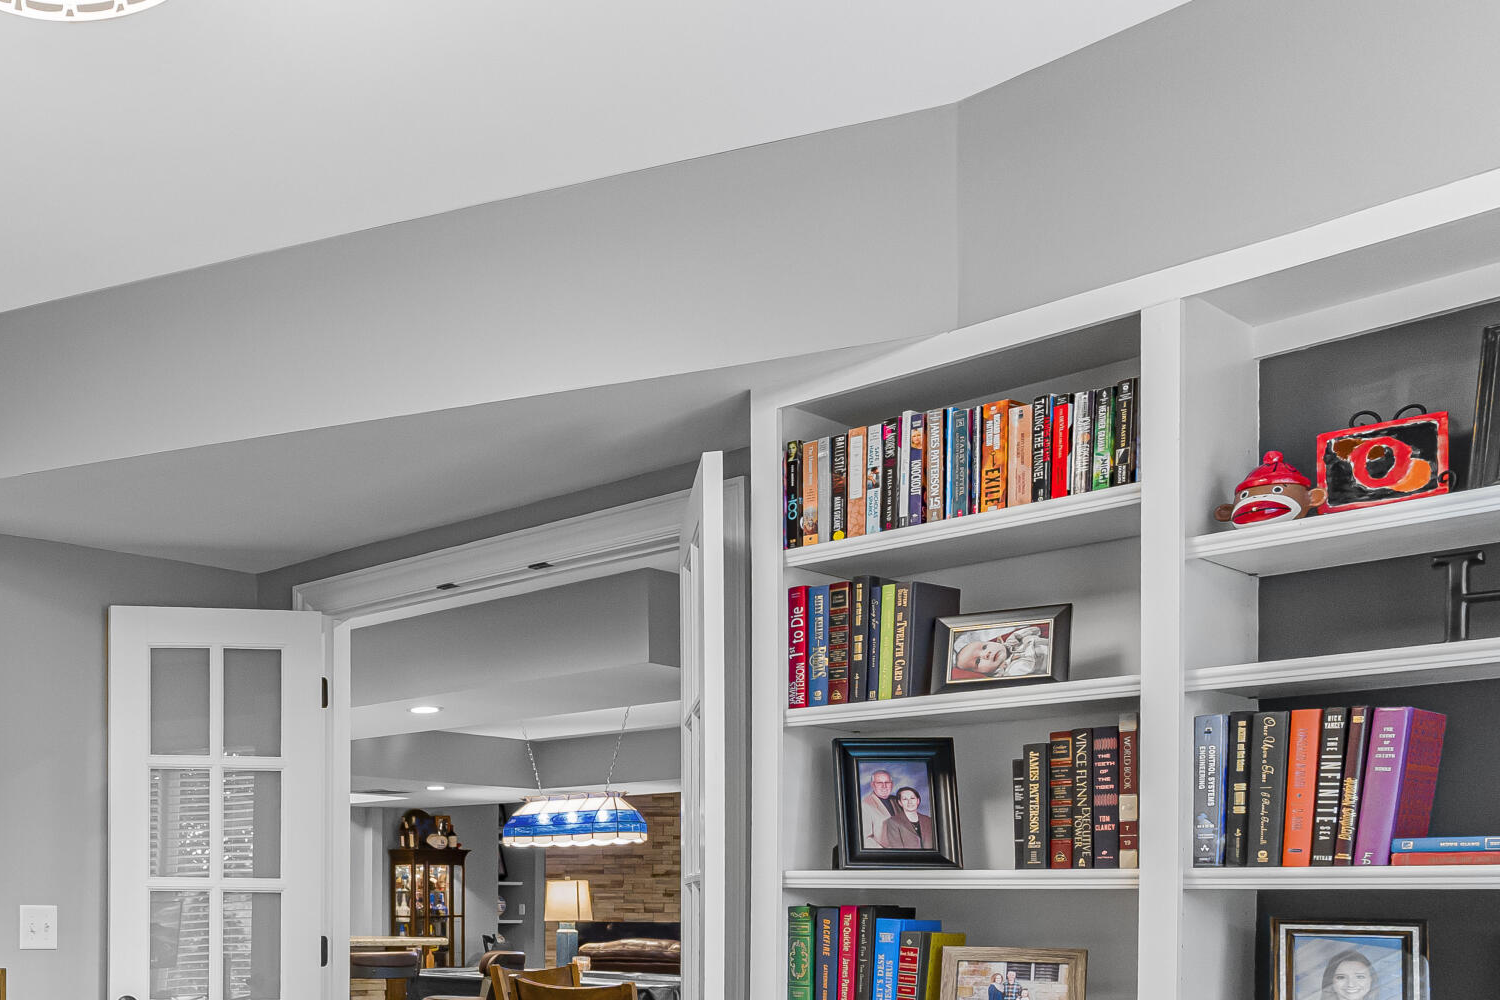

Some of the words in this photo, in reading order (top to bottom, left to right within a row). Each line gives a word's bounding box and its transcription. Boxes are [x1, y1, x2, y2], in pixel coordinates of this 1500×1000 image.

[1035, 398, 1045, 430] TAKING
[930, 423, 941, 448] JAMES
[1034, 432, 1044, 448] THE
[911, 459, 921, 496] KNOCKOUT
[930, 449, 941, 497] PATTERSON
[1033, 450, 1043, 482] TUNNEL
[985, 468, 1001, 506] EXILE
[791, 606, 804, 628] Die
[815, 595, 824, 614] KITTY
[794, 630, 804, 643] to
[815, 617, 824, 640] KELLEY
[896, 621, 908, 657] TWELFTH
[789, 646, 804, 660] 1st
[812, 646, 827, 680] ROYALS
[796, 662, 805, 704] PATTERSON
[894, 659, 906, 681] CARD
[789, 681, 797, 705] JAMES
[1263, 716, 1276, 736] Once
[1324, 721, 1344, 729] YANCEY
[1076, 733, 1087, 767] VINCE
[1123, 736, 1132, 765] WORLD
[1262, 736, 1276, 758] Upon
[1326, 737, 1339, 752] THE
[1029, 751, 1040, 781] JAMES
[1198, 745, 1206, 790] ENGINEERING
[1208, 745, 1216, 775] CONTROL
[1123, 766, 1132, 790] BOOK
[1261, 765, 1275, 783] Time
[1076, 770, 1087, 807] FLYNN
[1207, 776, 1216, 807] SYSTEMS
[1316, 754, 1342, 824] INFINITE
[1029, 783, 1039, 833] PATTERSON
[1074, 815, 1083, 848] POWER
[1082, 807, 1091, 857] EXECUTIVE
[1319, 825, 1330, 840] SEA
[844, 914, 852, 925] The
[822, 919, 831, 956] BACKFIRE
[843, 927, 852, 952] Quickie
[842, 957, 850, 978] James
[877, 954, 885, 977] DESK
